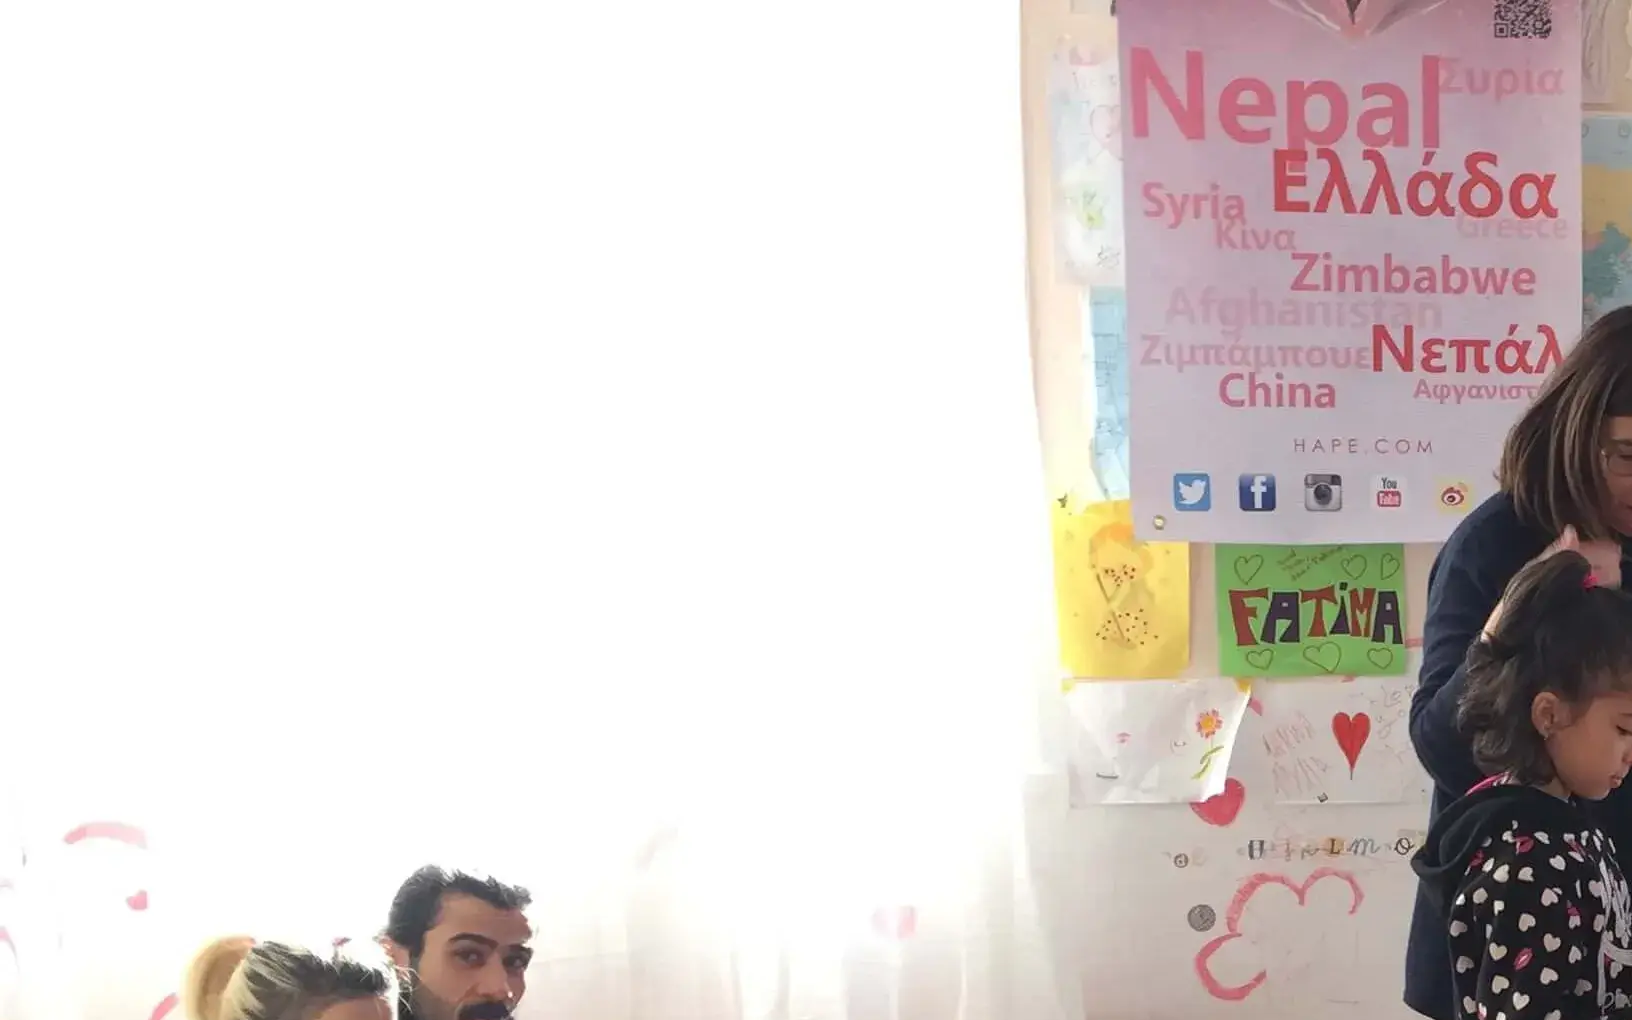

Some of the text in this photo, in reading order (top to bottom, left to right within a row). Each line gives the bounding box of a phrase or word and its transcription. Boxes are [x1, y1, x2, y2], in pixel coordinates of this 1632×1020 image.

[1440, 57, 1565, 105] Συρία
[1131, 47, 1440, 172] Nepal
[1142, 182, 1247, 229] Syria
[1272, 148, 1559, 218] Ελλάδα
[1456, 211, 1568, 239] Greece
[1290, 252, 1537, 295] Zimbabwe
[1165, 285, 1443, 336] Afghanistan
[1372, 323, 1567, 374] Νεπάλ
[1219, 371, 1337, 408] China
[1413, 378, 1541, 404] Αφγανιστ
[1293, 438, 1434, 454] HAPE.COM
